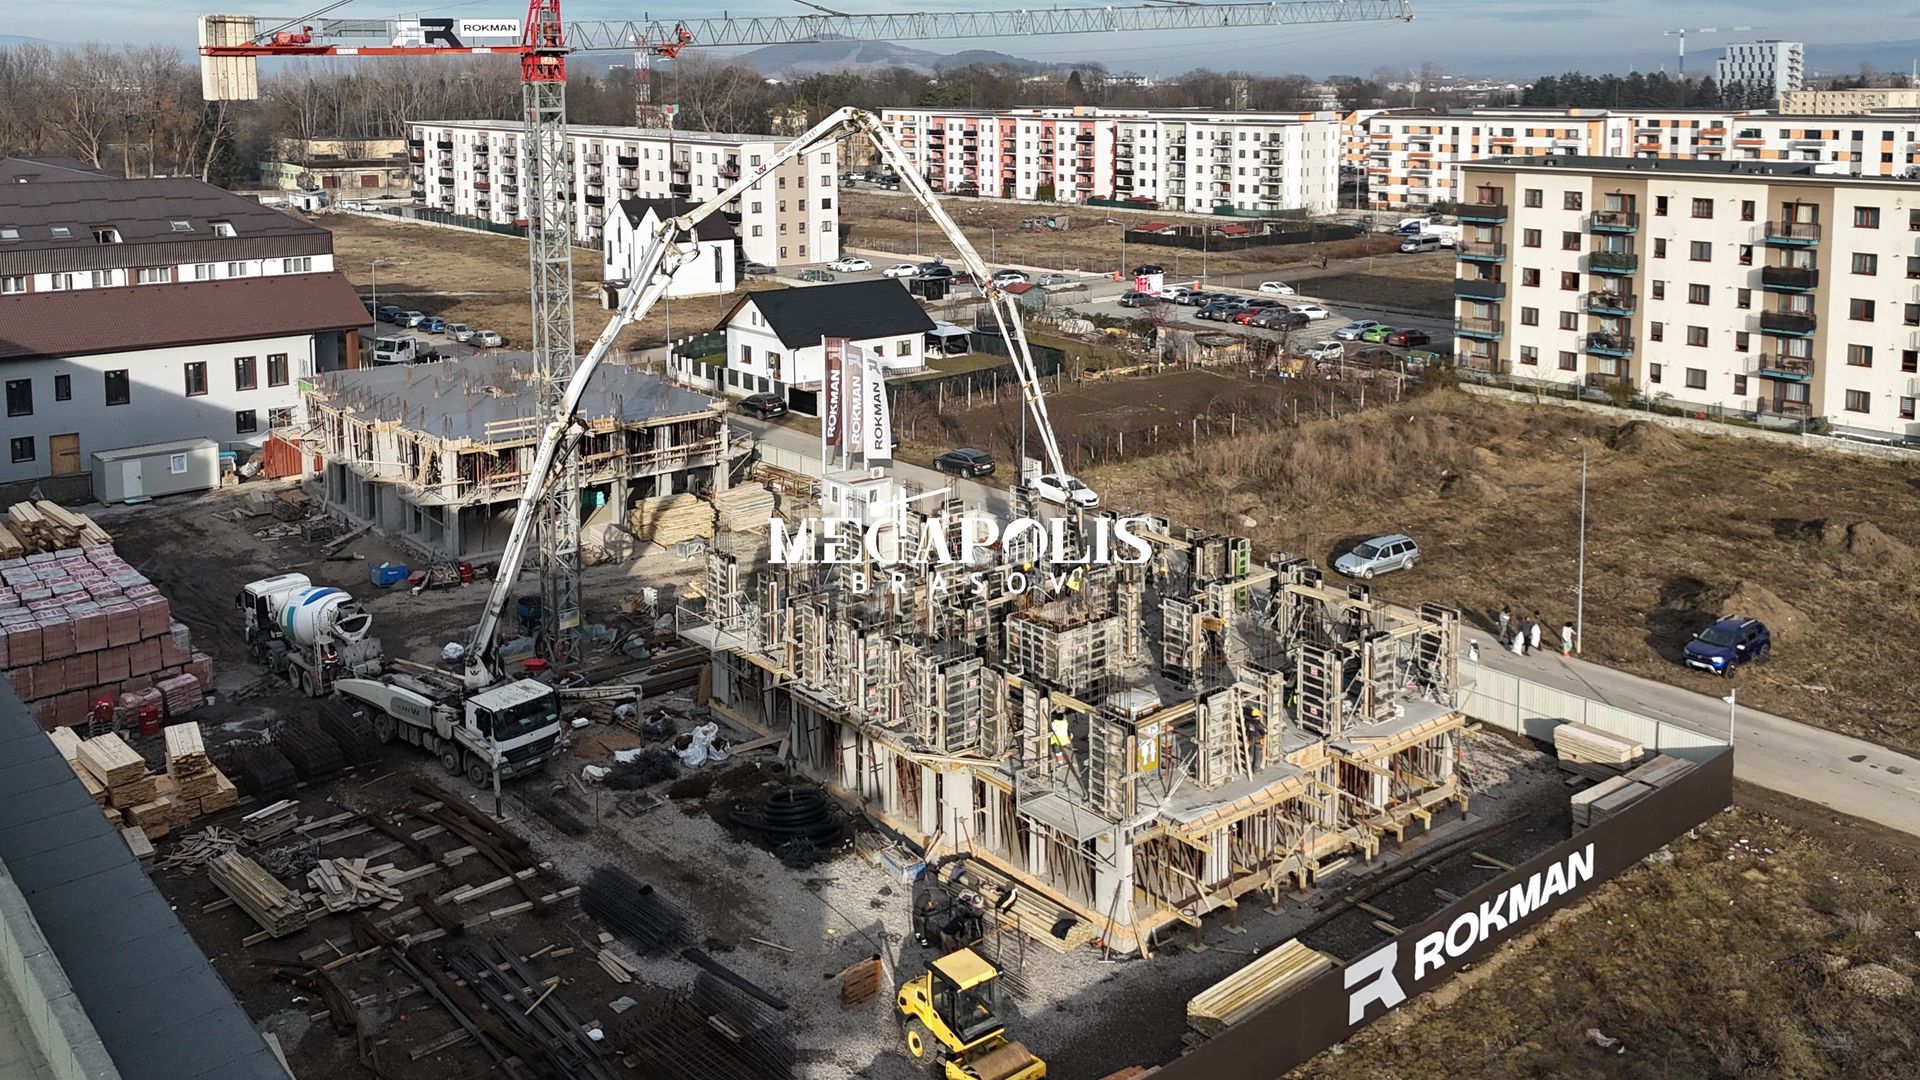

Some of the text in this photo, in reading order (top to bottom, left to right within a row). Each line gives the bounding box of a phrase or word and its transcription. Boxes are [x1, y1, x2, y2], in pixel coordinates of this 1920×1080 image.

[827, 370, 840, 438] ROKMAN
[851, 376, 862, 444] ROKMAN
[872, 382, 883, 450] ROKMAN
[1414, 843, 1594, 981] ROKMAN
